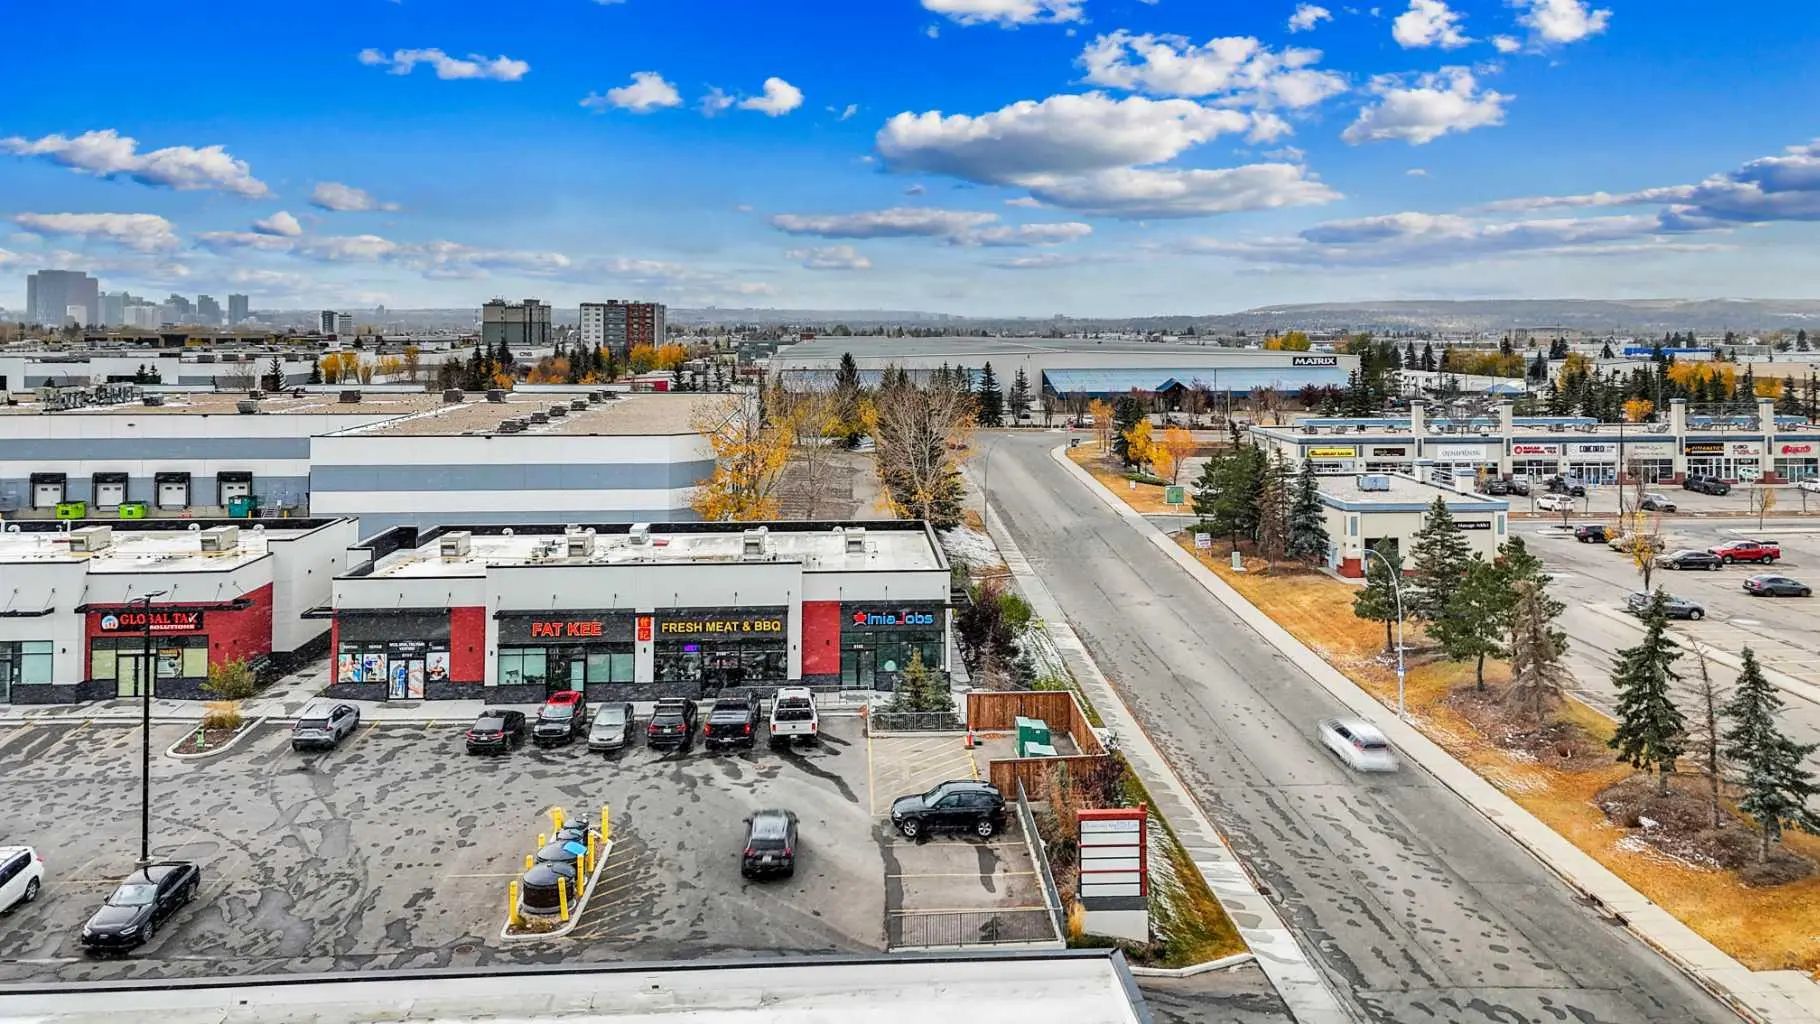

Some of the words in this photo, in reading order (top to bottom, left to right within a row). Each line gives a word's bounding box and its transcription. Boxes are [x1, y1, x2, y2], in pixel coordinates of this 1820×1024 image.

[1295, 357, 1335, 365] MATRIX
[120, 613, 170, 625] GLOBAL
[531, 622, 563, 637] FAT
[567, 621, 602, 636] KEE
[661, 621, 702, 633] FRESH
[705, 621, 739, 632] MEAT
[742, 621, 751, 632] &
[754, 620, 781, 632] BBQ
